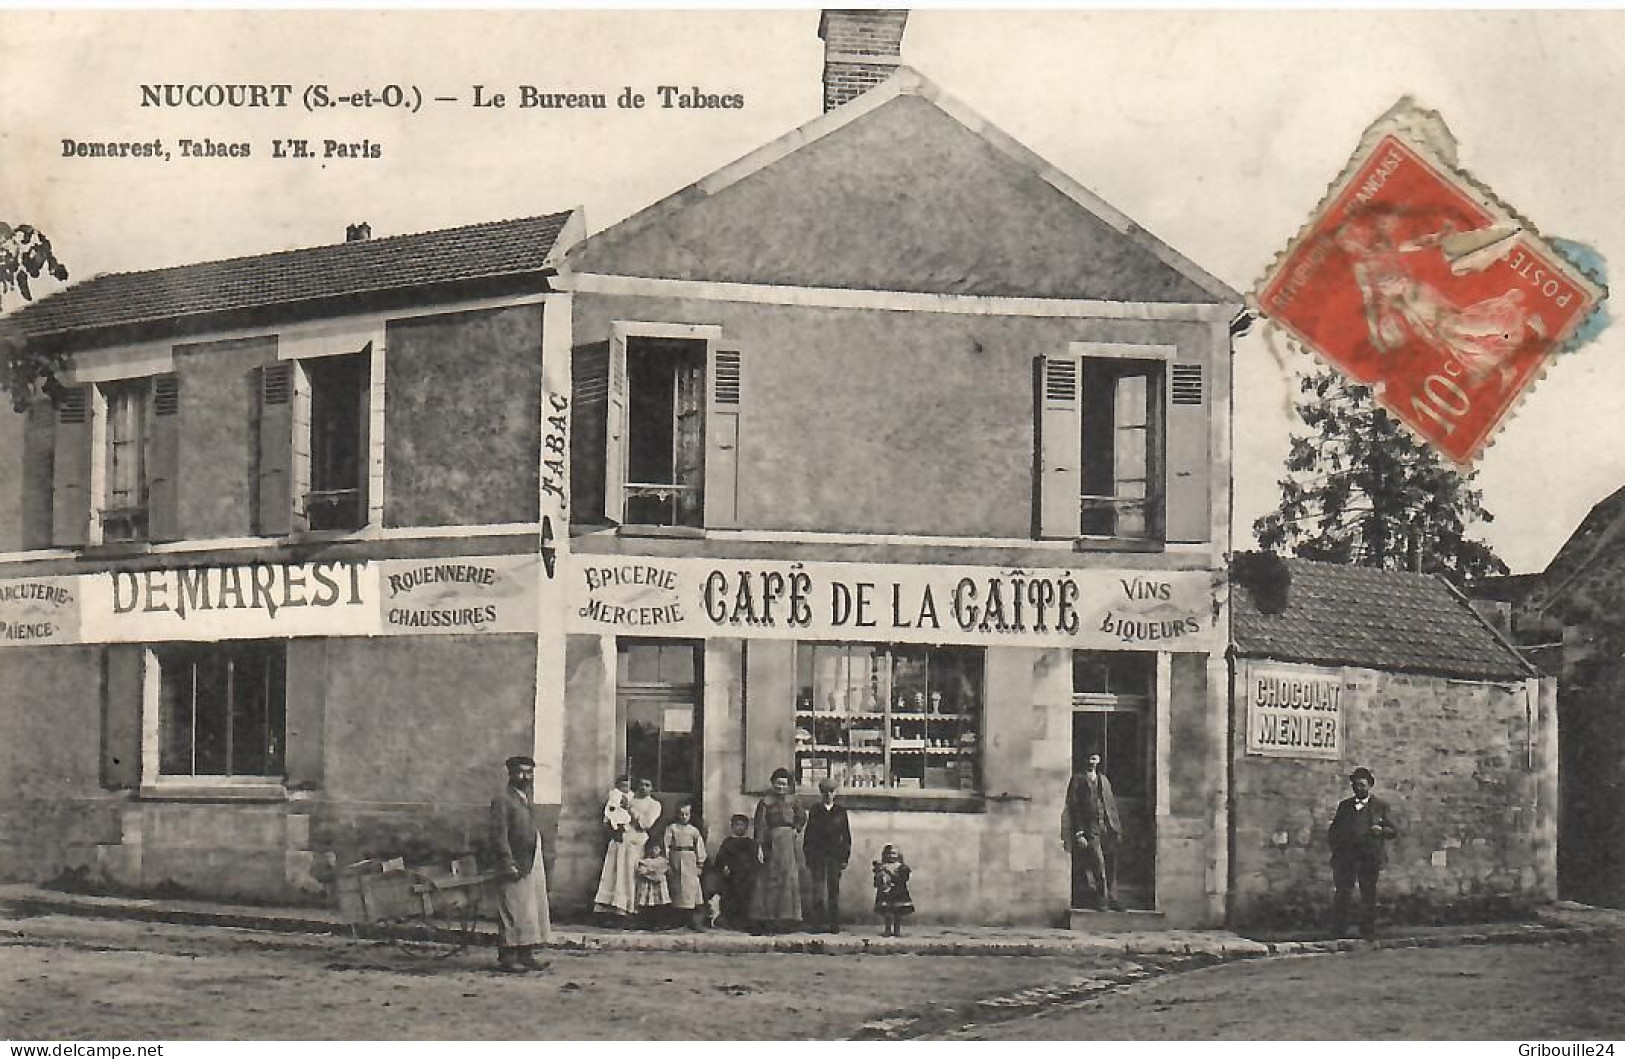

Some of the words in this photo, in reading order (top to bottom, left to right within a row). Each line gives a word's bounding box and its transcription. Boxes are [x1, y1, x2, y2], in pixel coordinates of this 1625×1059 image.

[542, 392, 568, 510] TABAC
[112, 562, 366, 620] DEMAREST
[388, 564, 496, 599] ROUENNERIE
[700, 562, 812, 628] CAFÉ
[831, 581, 877, 627] DE
[892, 583, 940, 629] LA
[1120, 577, 1171, 601] VINS
[388, 605, 497, 631] CHAUSSURES
[578, 598, 684, 625] MERCERIE
[1099, 610, 1200, 643] LIQUEURS
[1256, 677, 1339, 712] CHOCOLAT
[1258, 713, 1336, 748] MENIER
